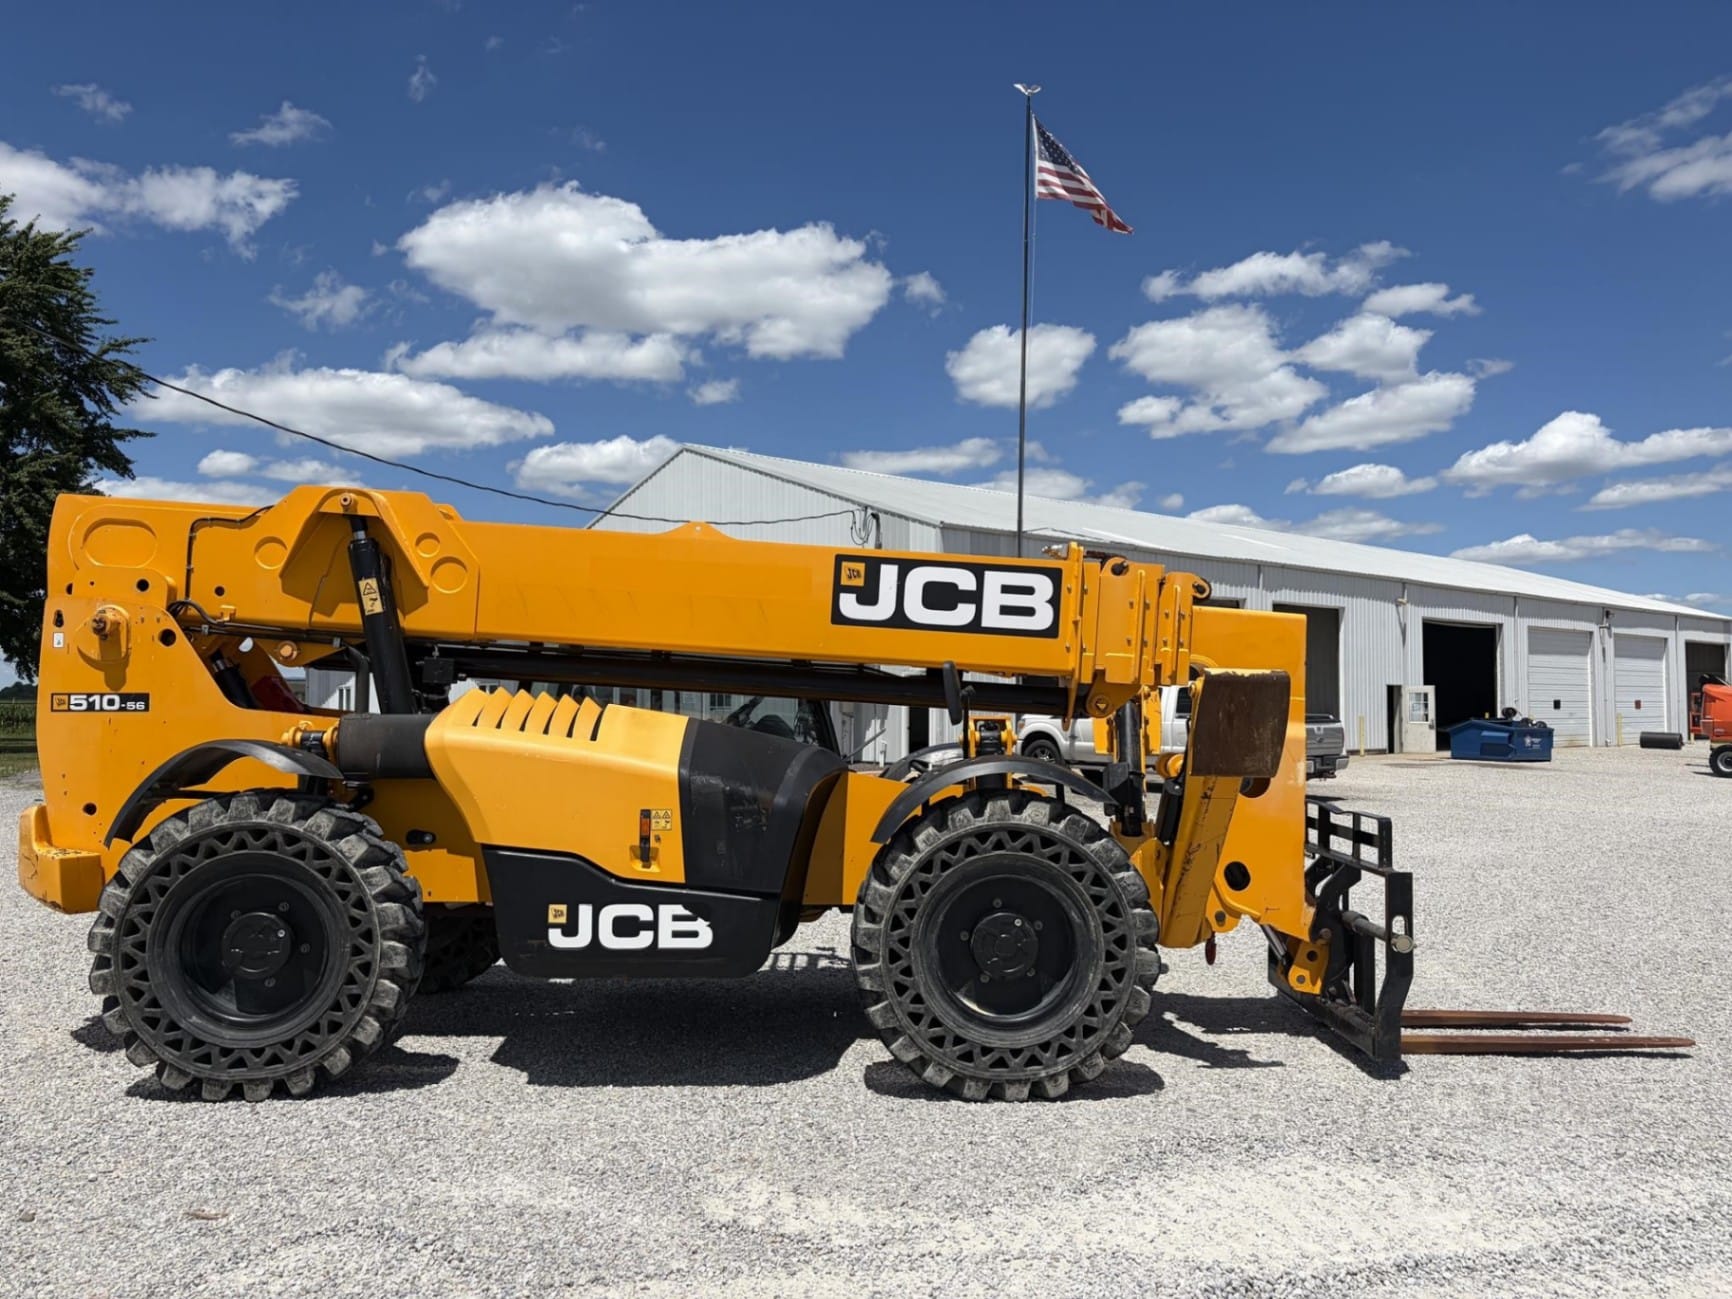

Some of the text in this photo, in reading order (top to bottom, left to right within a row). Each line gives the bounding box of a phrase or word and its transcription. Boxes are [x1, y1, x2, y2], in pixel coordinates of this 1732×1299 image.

[839, 564, 1054, 630] JCB
[70, 694, 145, 711] 510-56
[548, 904, 713, 949] JCB
